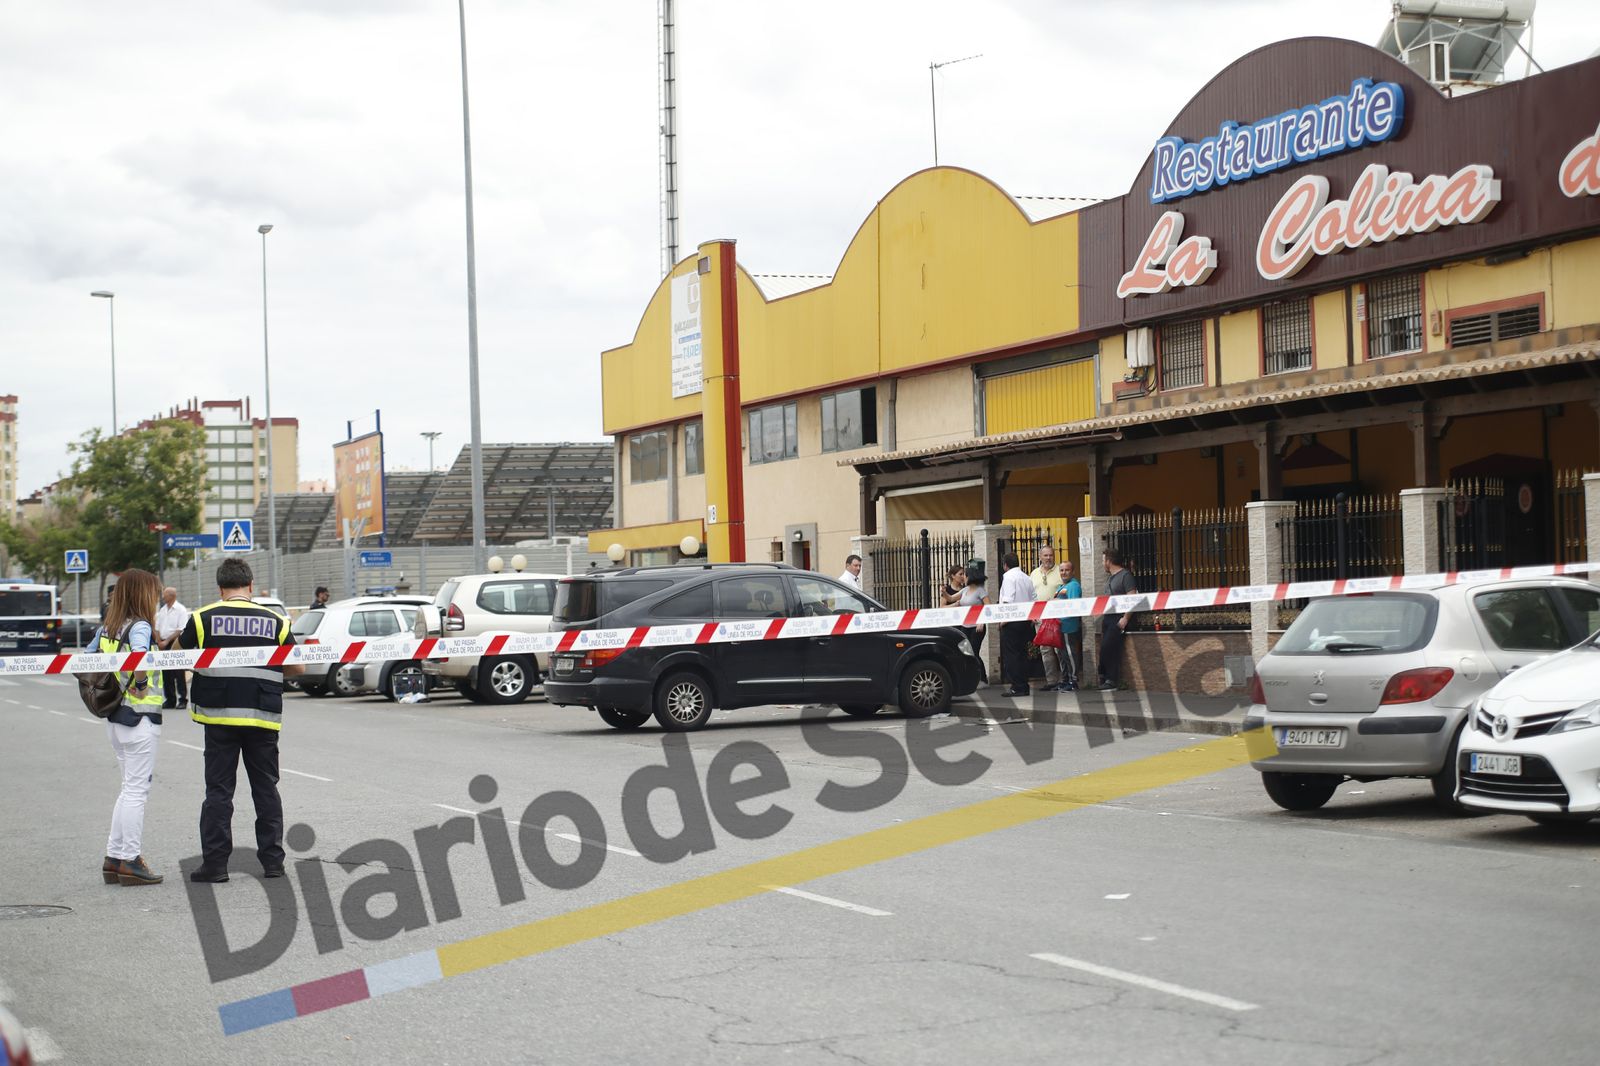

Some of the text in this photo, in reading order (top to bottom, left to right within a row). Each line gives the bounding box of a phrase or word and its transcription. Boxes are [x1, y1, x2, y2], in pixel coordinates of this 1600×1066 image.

[1150, 78, 1404, 204] Restaurante
[1117, 211, 1217, 299] La
[1256, 163, 1501, 281] Colina
[213, 616, 274, 638] POLICIA
[1288, 730, 1314, 744] 9401
[1478, 756, 1519, 773] 2441 JGB
